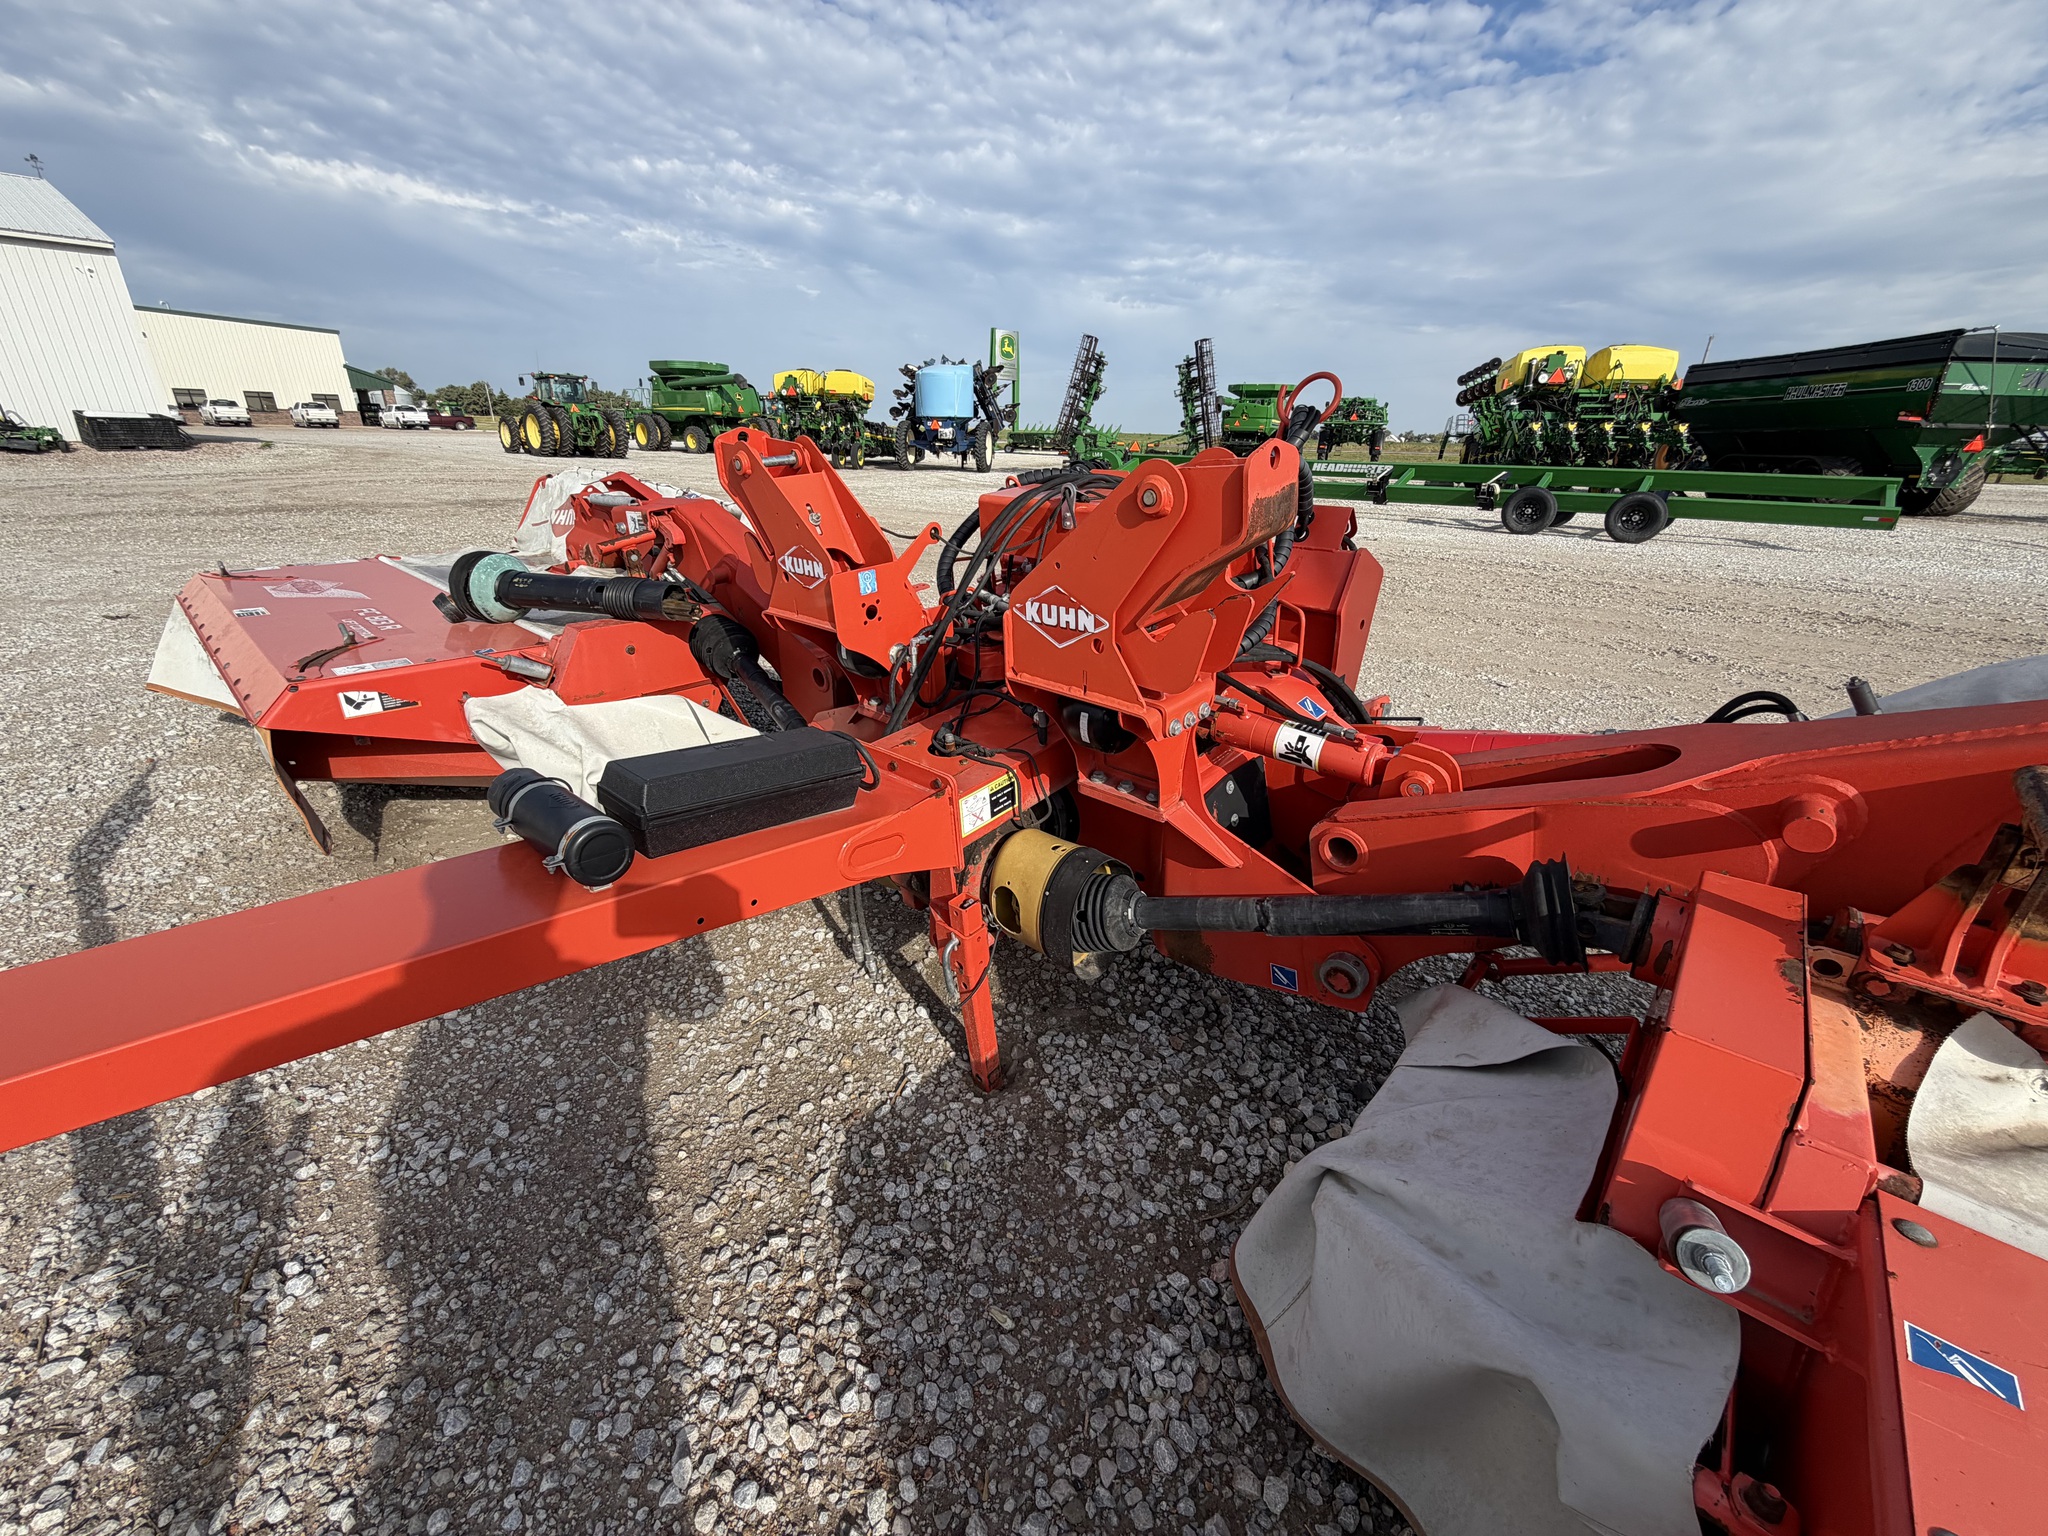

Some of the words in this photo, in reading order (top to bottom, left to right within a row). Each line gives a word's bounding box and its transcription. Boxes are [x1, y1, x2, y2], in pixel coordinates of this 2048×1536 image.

[1783, 382, 1848, 401] HAULMASTER
[1906, 377, 1934, 392] 1300
[785, 554, 824, 579] KUHN
[1025, 600, 1097, 633] KUHN
